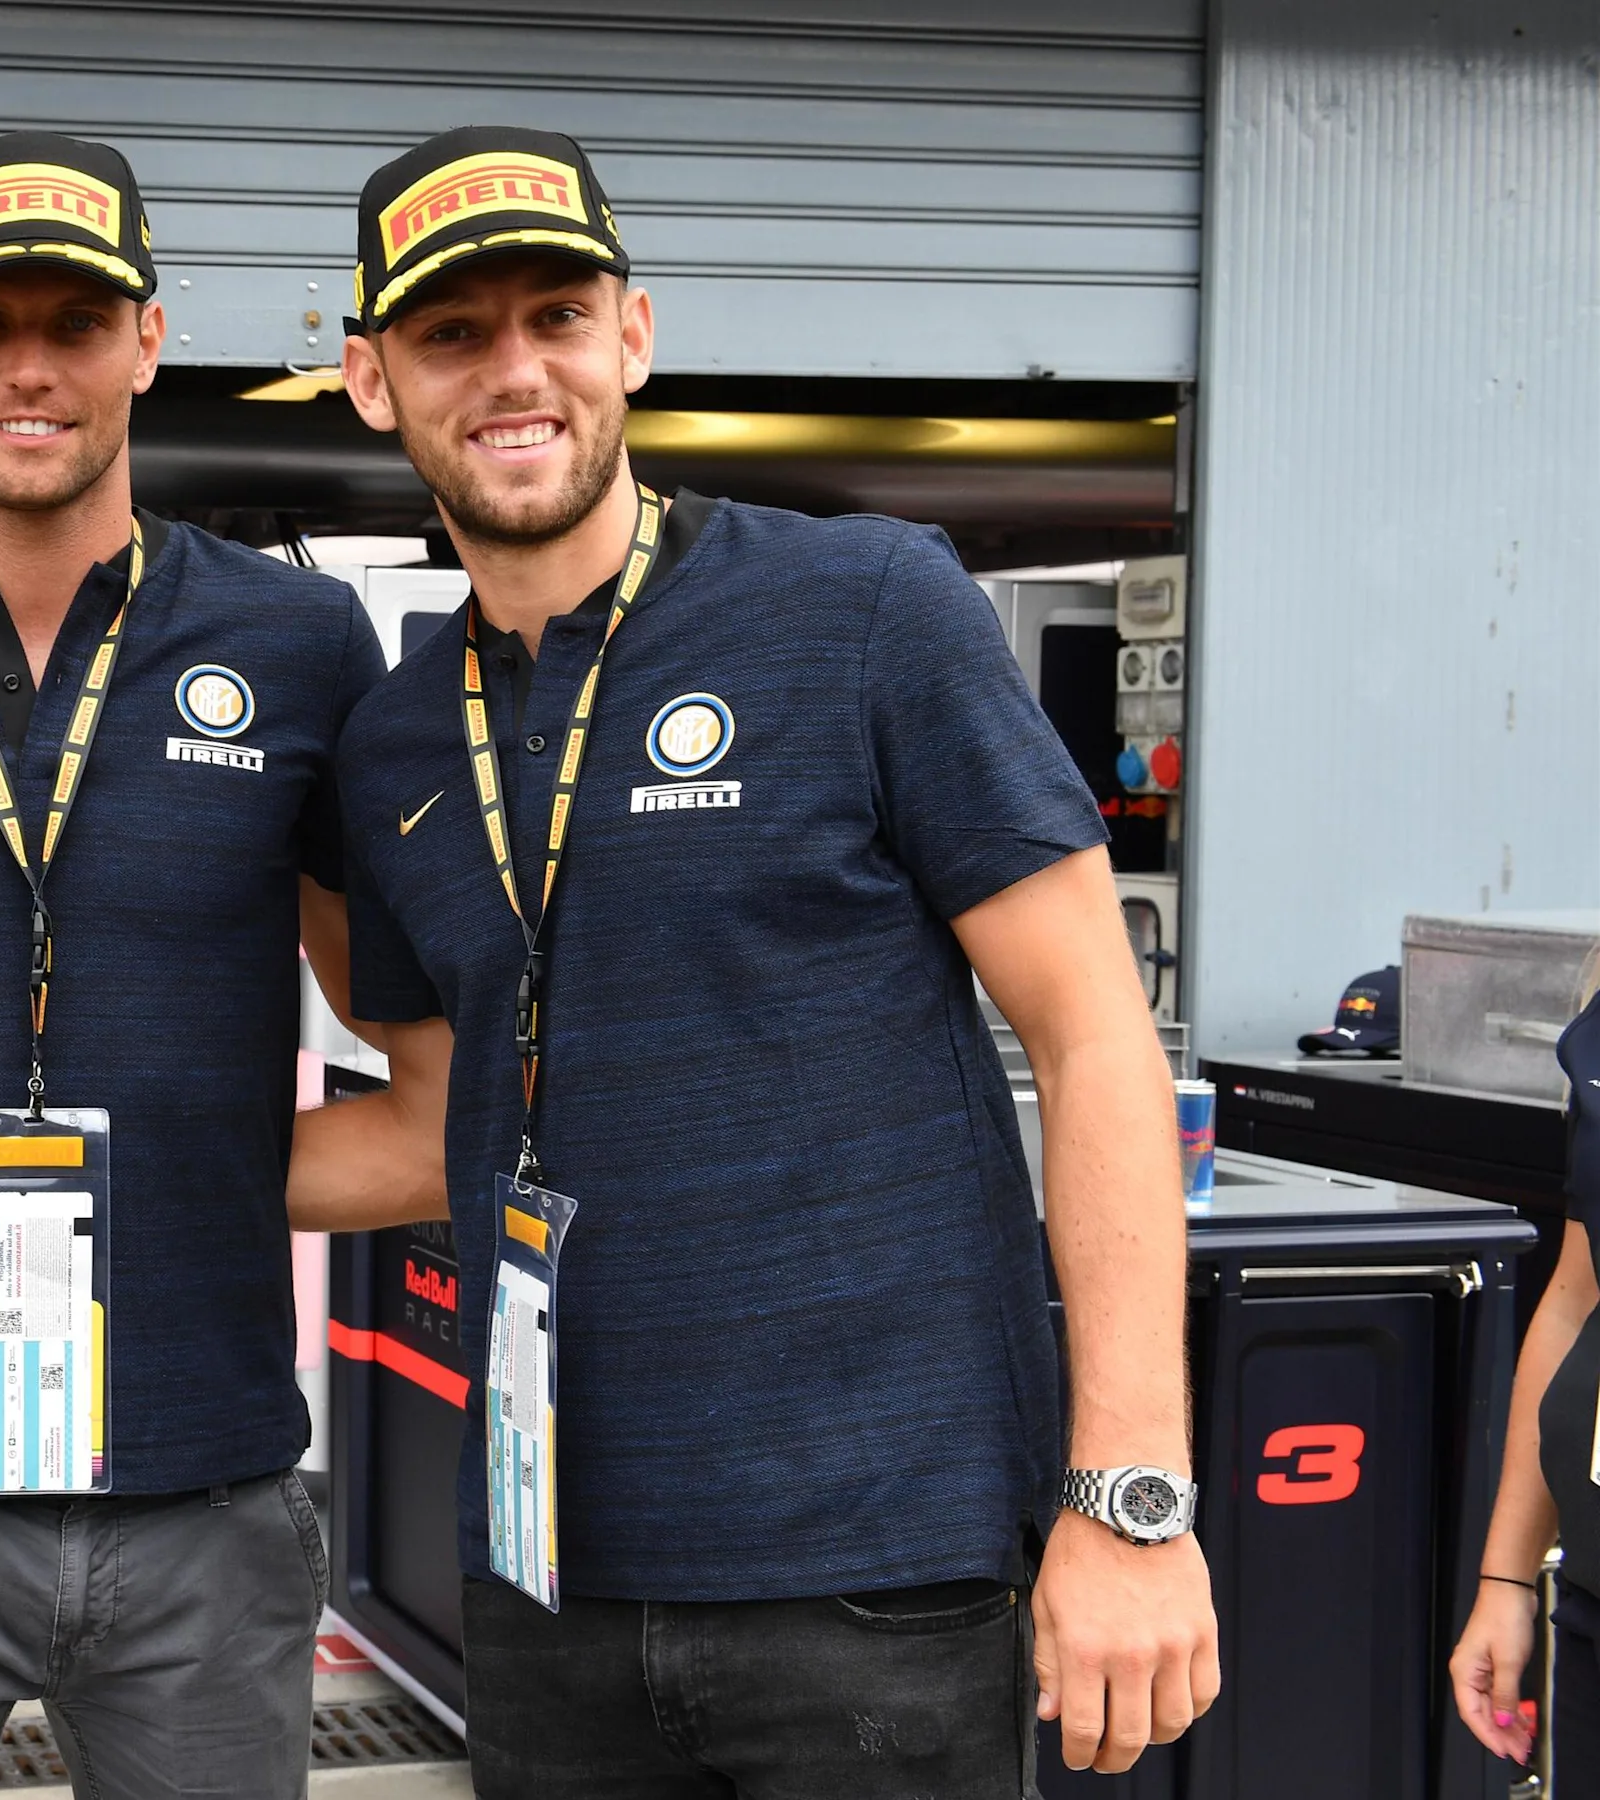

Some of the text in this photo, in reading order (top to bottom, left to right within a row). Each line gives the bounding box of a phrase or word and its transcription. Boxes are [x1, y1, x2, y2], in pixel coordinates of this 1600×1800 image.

[389, 165, 570, 252] PIRELLI
[470, 703, 484, 741] PIRELLI
[166, 737, 265, 773] PIRELLI
[630, 781, 742, 813] PIRELLI
[1260, 1090, 1315, 1110] VERSTAPPEN
[14, 1224, 22, 1298] www.monzanet.it
[1256, 1423, 1365, 1505] 3
